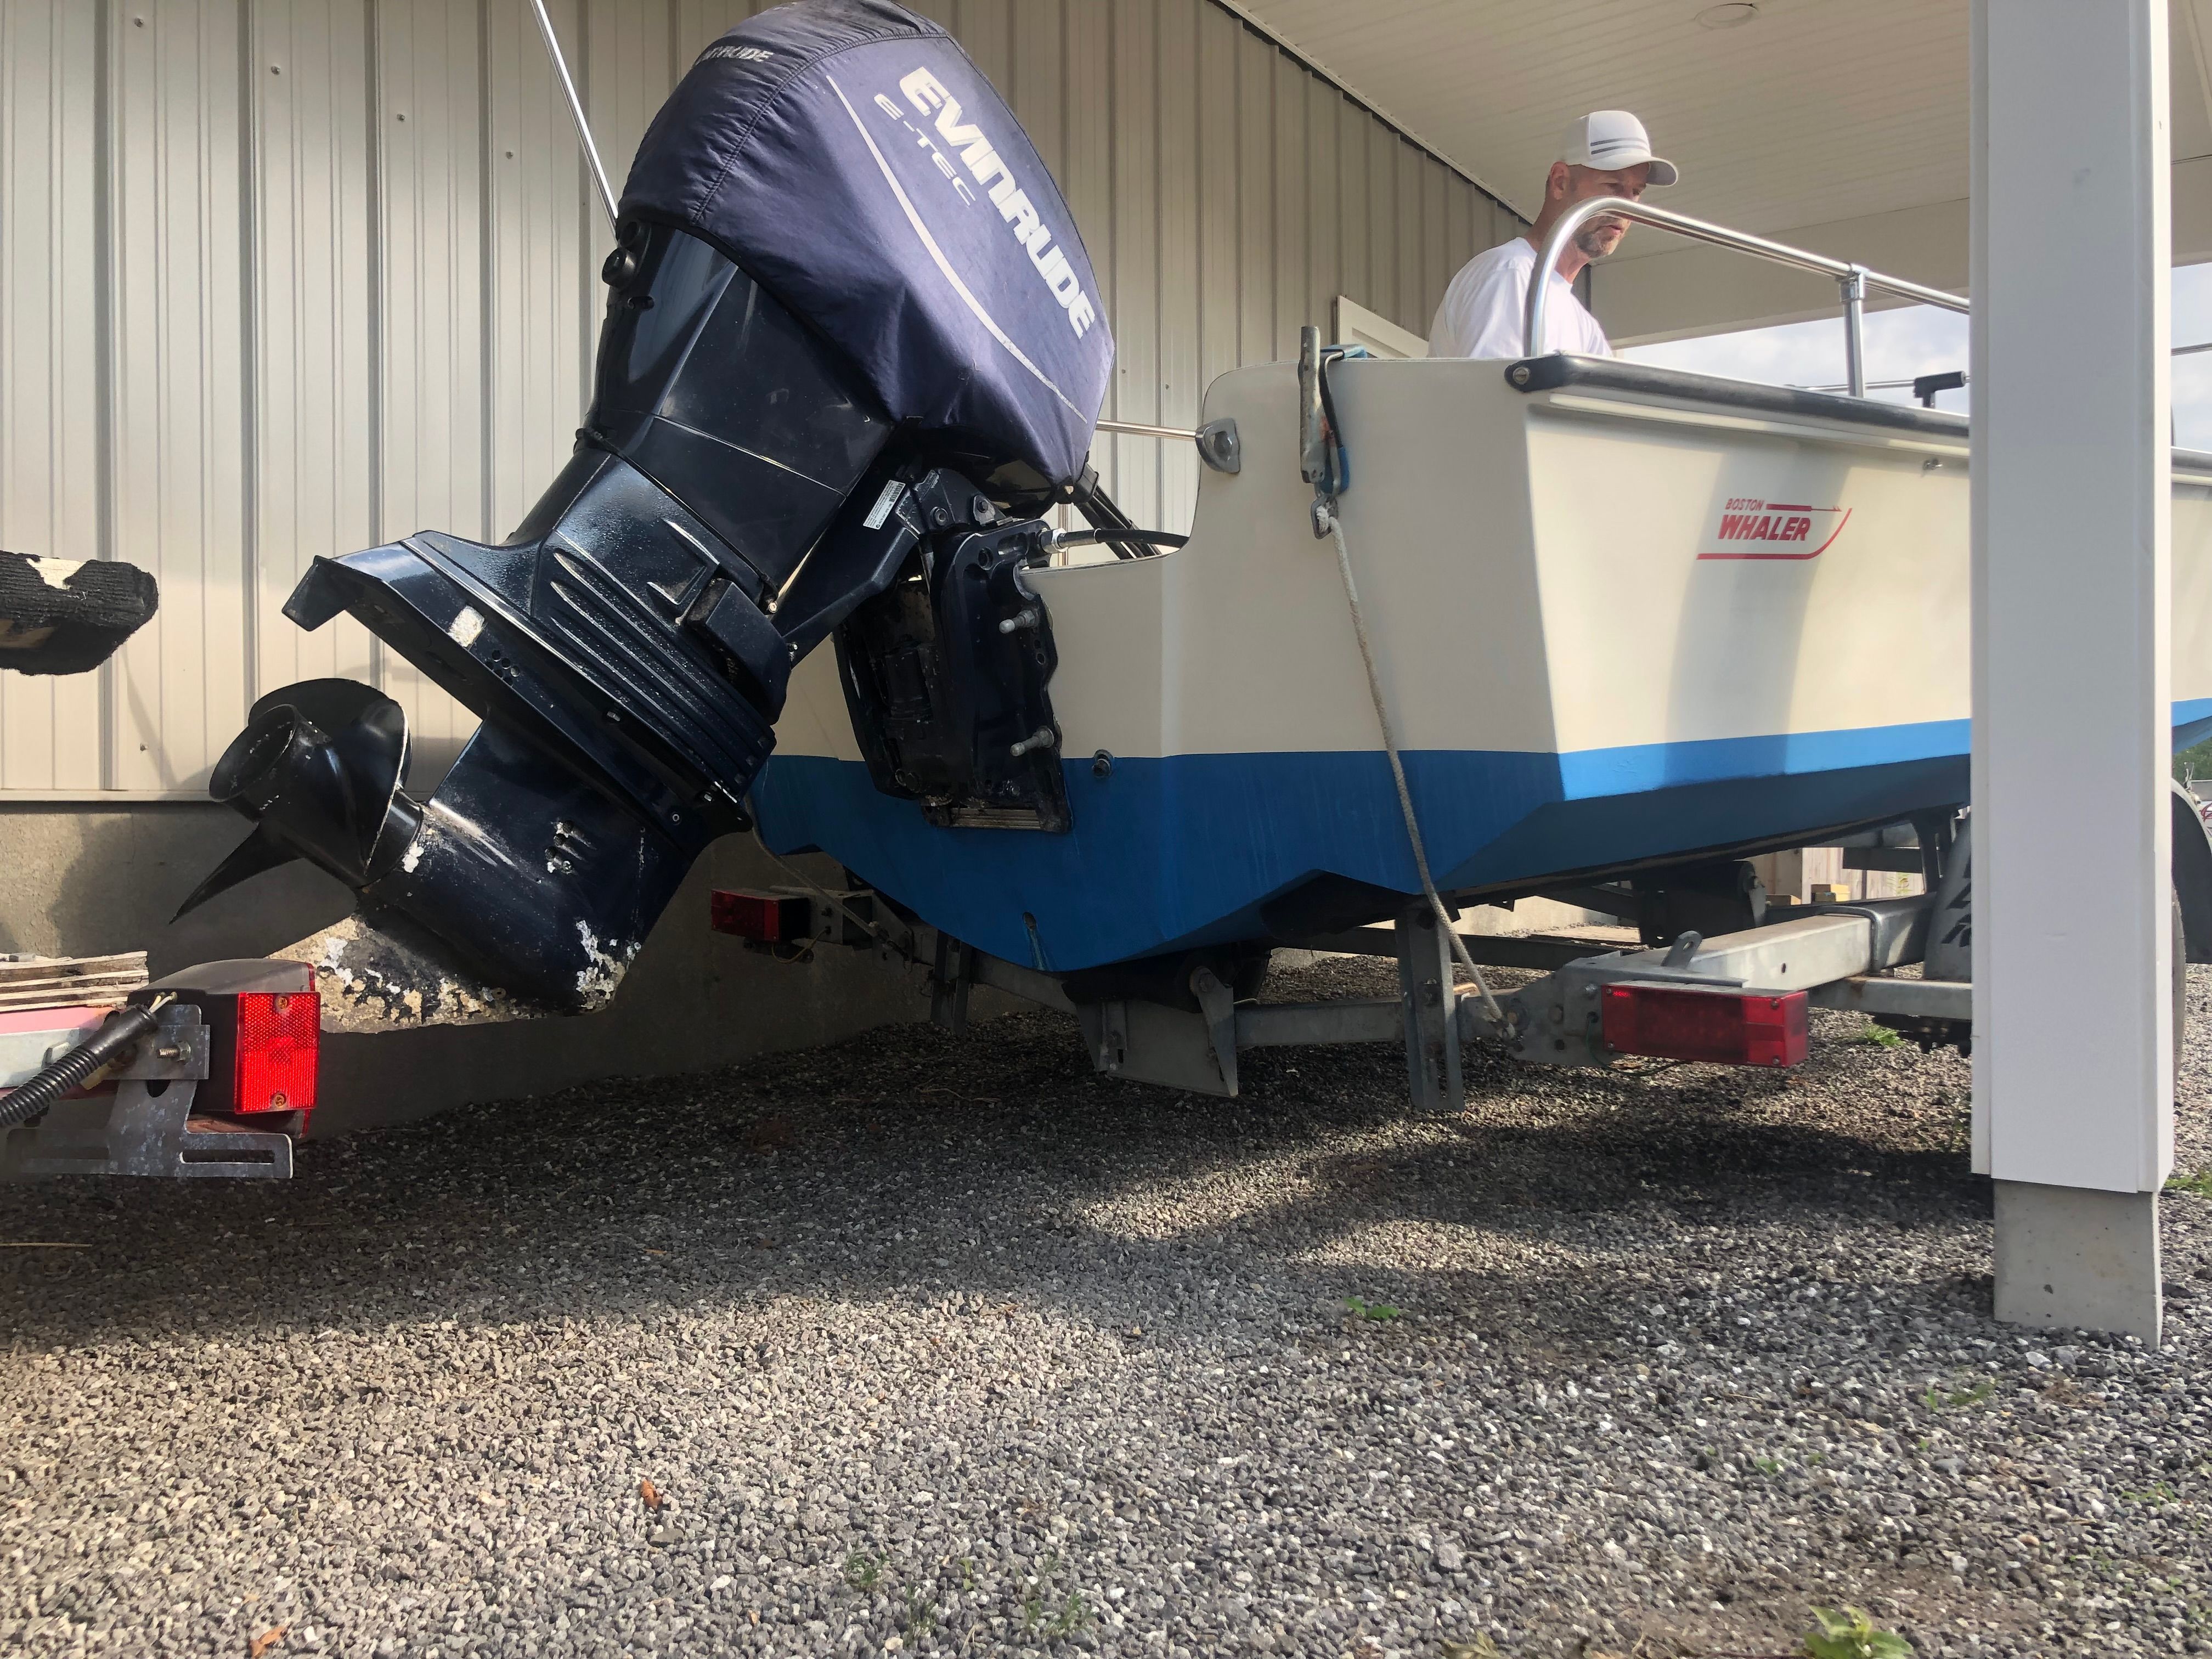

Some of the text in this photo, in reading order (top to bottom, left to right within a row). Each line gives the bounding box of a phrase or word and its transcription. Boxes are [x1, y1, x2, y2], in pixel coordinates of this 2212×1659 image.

[873, 93, 977, 206] E-TEC
[899, 66, 1096, 340] EVINRUDE
[1717, 514, 1812, 541] WHALER
[1725, 498, 1764, 511] BOSTON
